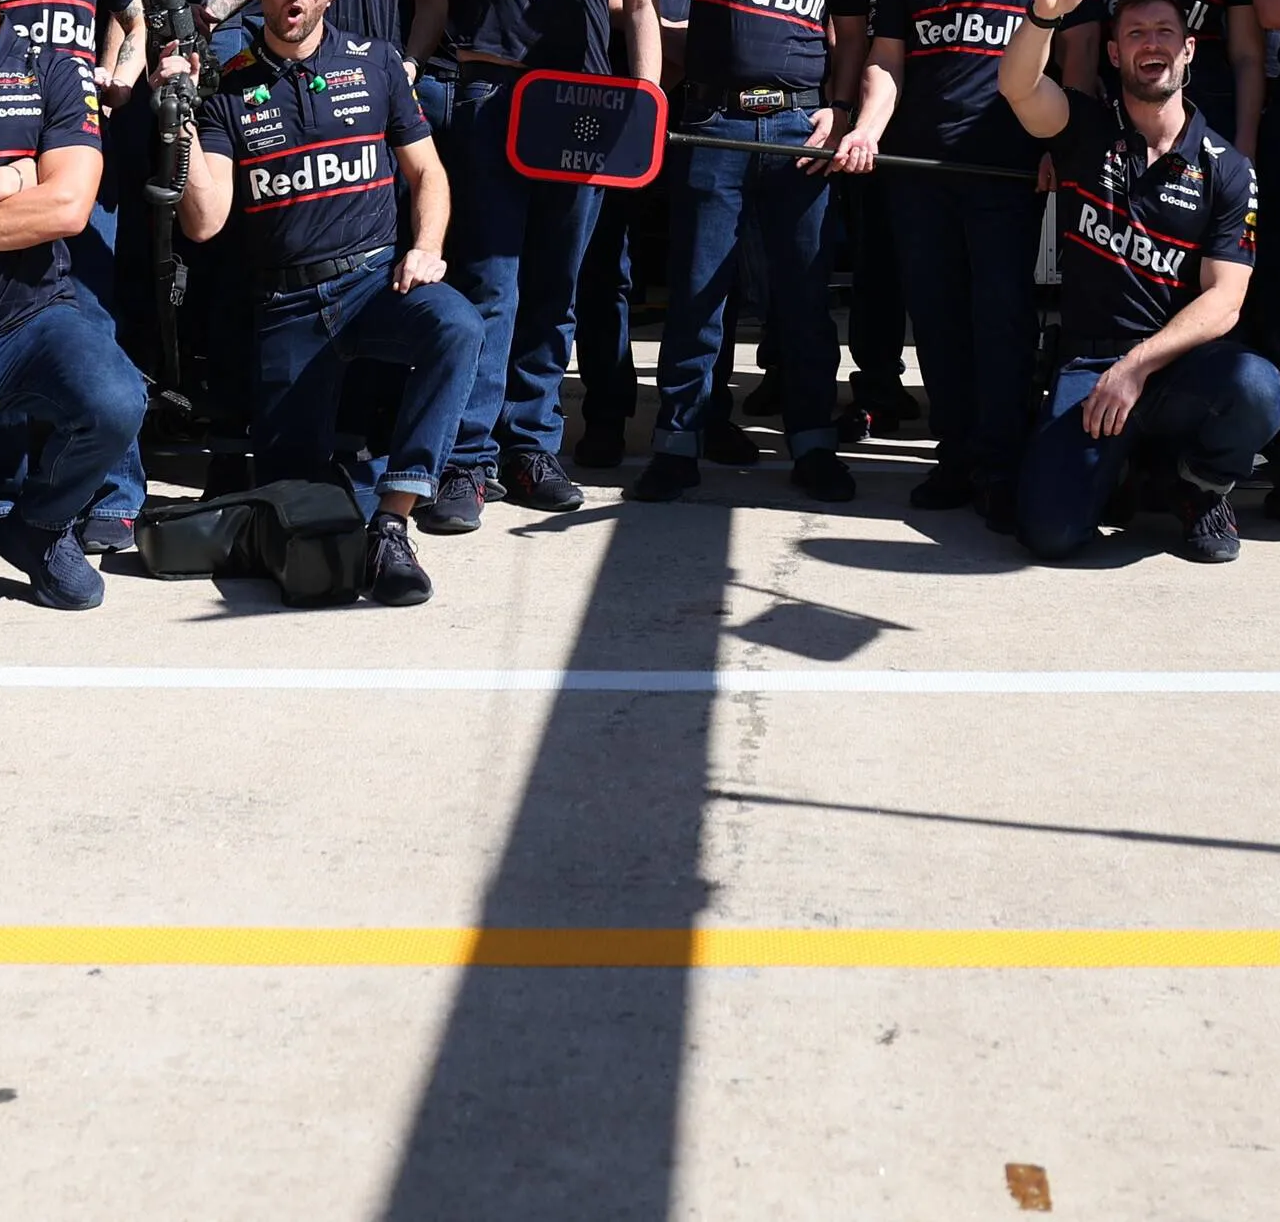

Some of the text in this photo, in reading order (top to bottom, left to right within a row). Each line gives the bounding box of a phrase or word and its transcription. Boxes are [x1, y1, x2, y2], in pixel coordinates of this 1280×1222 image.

[13, 9, 49, 43] ed
[916, 13, 1023, 46] Red Bull
[325, 67, 363, 79] ORACLE
[331, 90, 369, 102] HONDA
[556, 84, 626, 110] LAUNCH
[757, 96, 780, 105] CREW
[240, 109, 270, 125] Mobil
[243, 122, 283, 137] ORACLE
[560, 149, 606, 173] REVS
[249, 144, 377, 201] Red Bull
[1168, 193, 1197, 212] Gate.io
[1079, 203, 1185, 281] Red Bull
